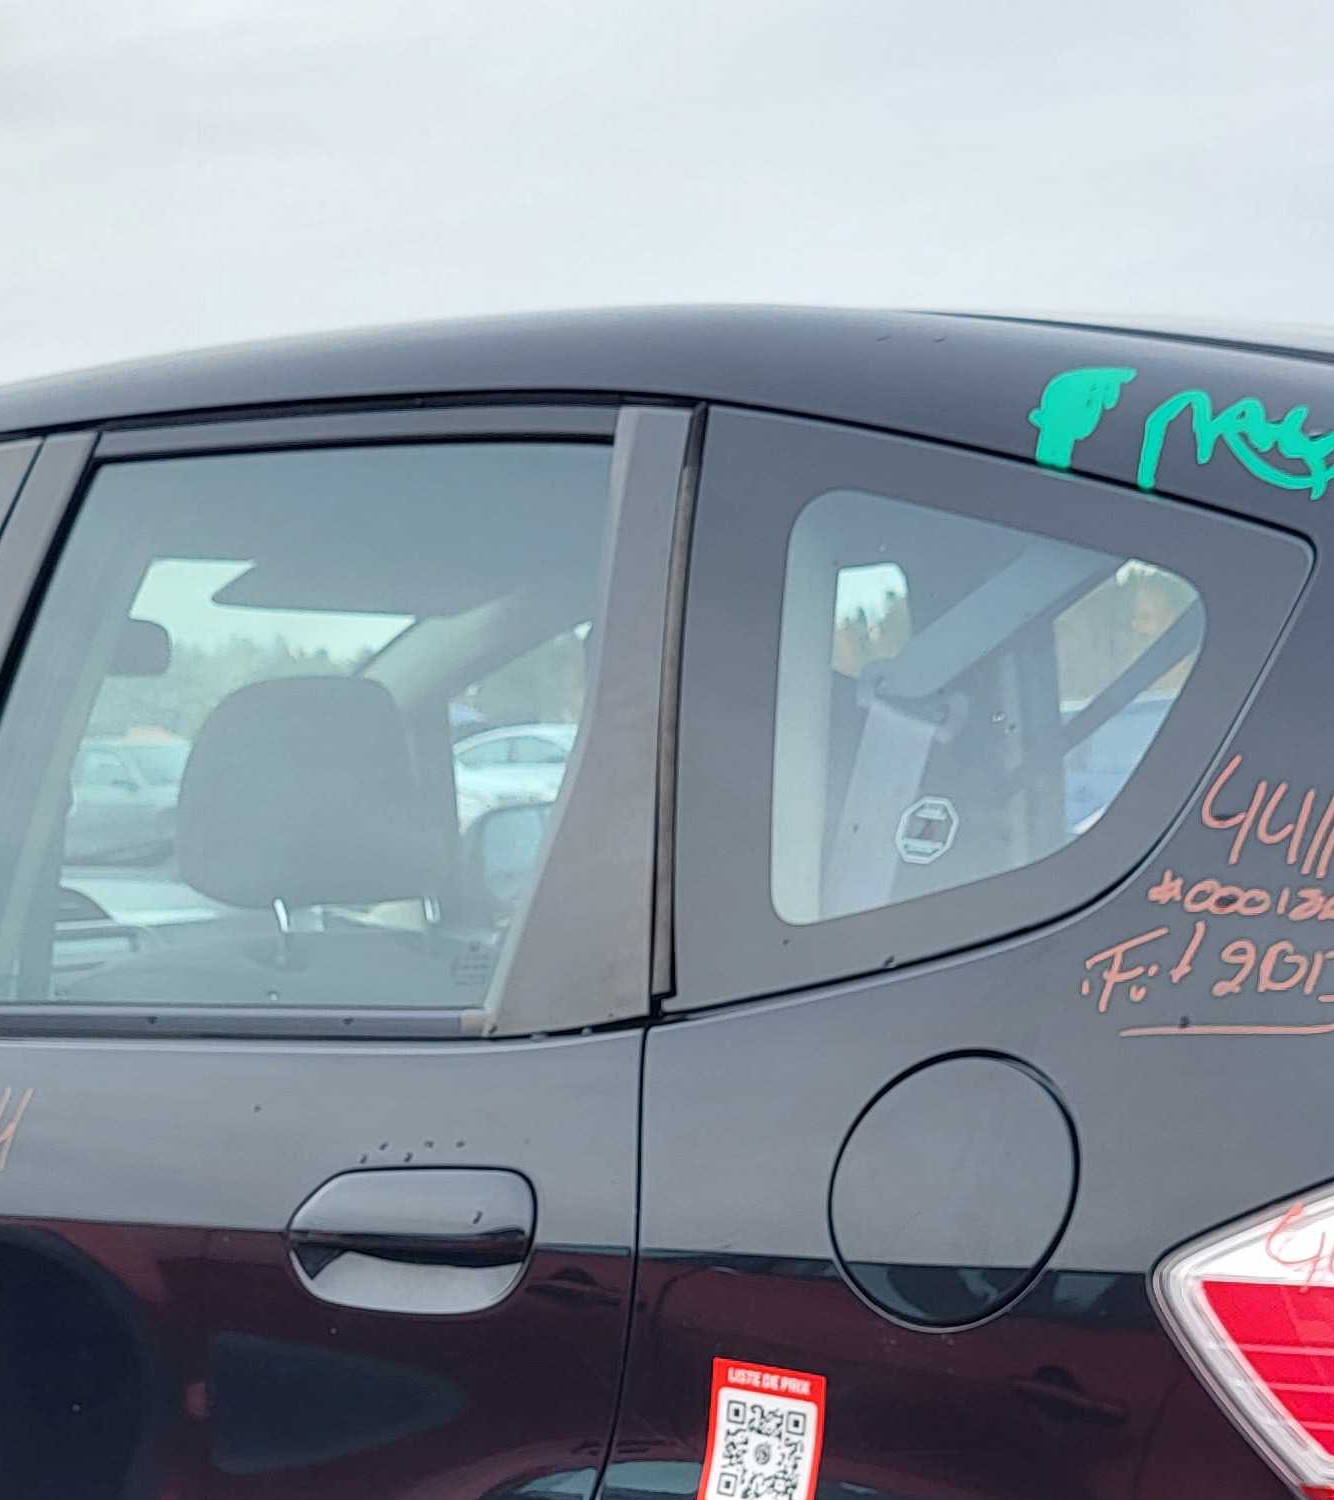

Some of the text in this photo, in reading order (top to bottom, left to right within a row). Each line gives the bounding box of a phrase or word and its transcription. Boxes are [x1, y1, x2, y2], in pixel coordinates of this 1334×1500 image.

[727, 1366, 811, 1395] LISTE DE PRIX
